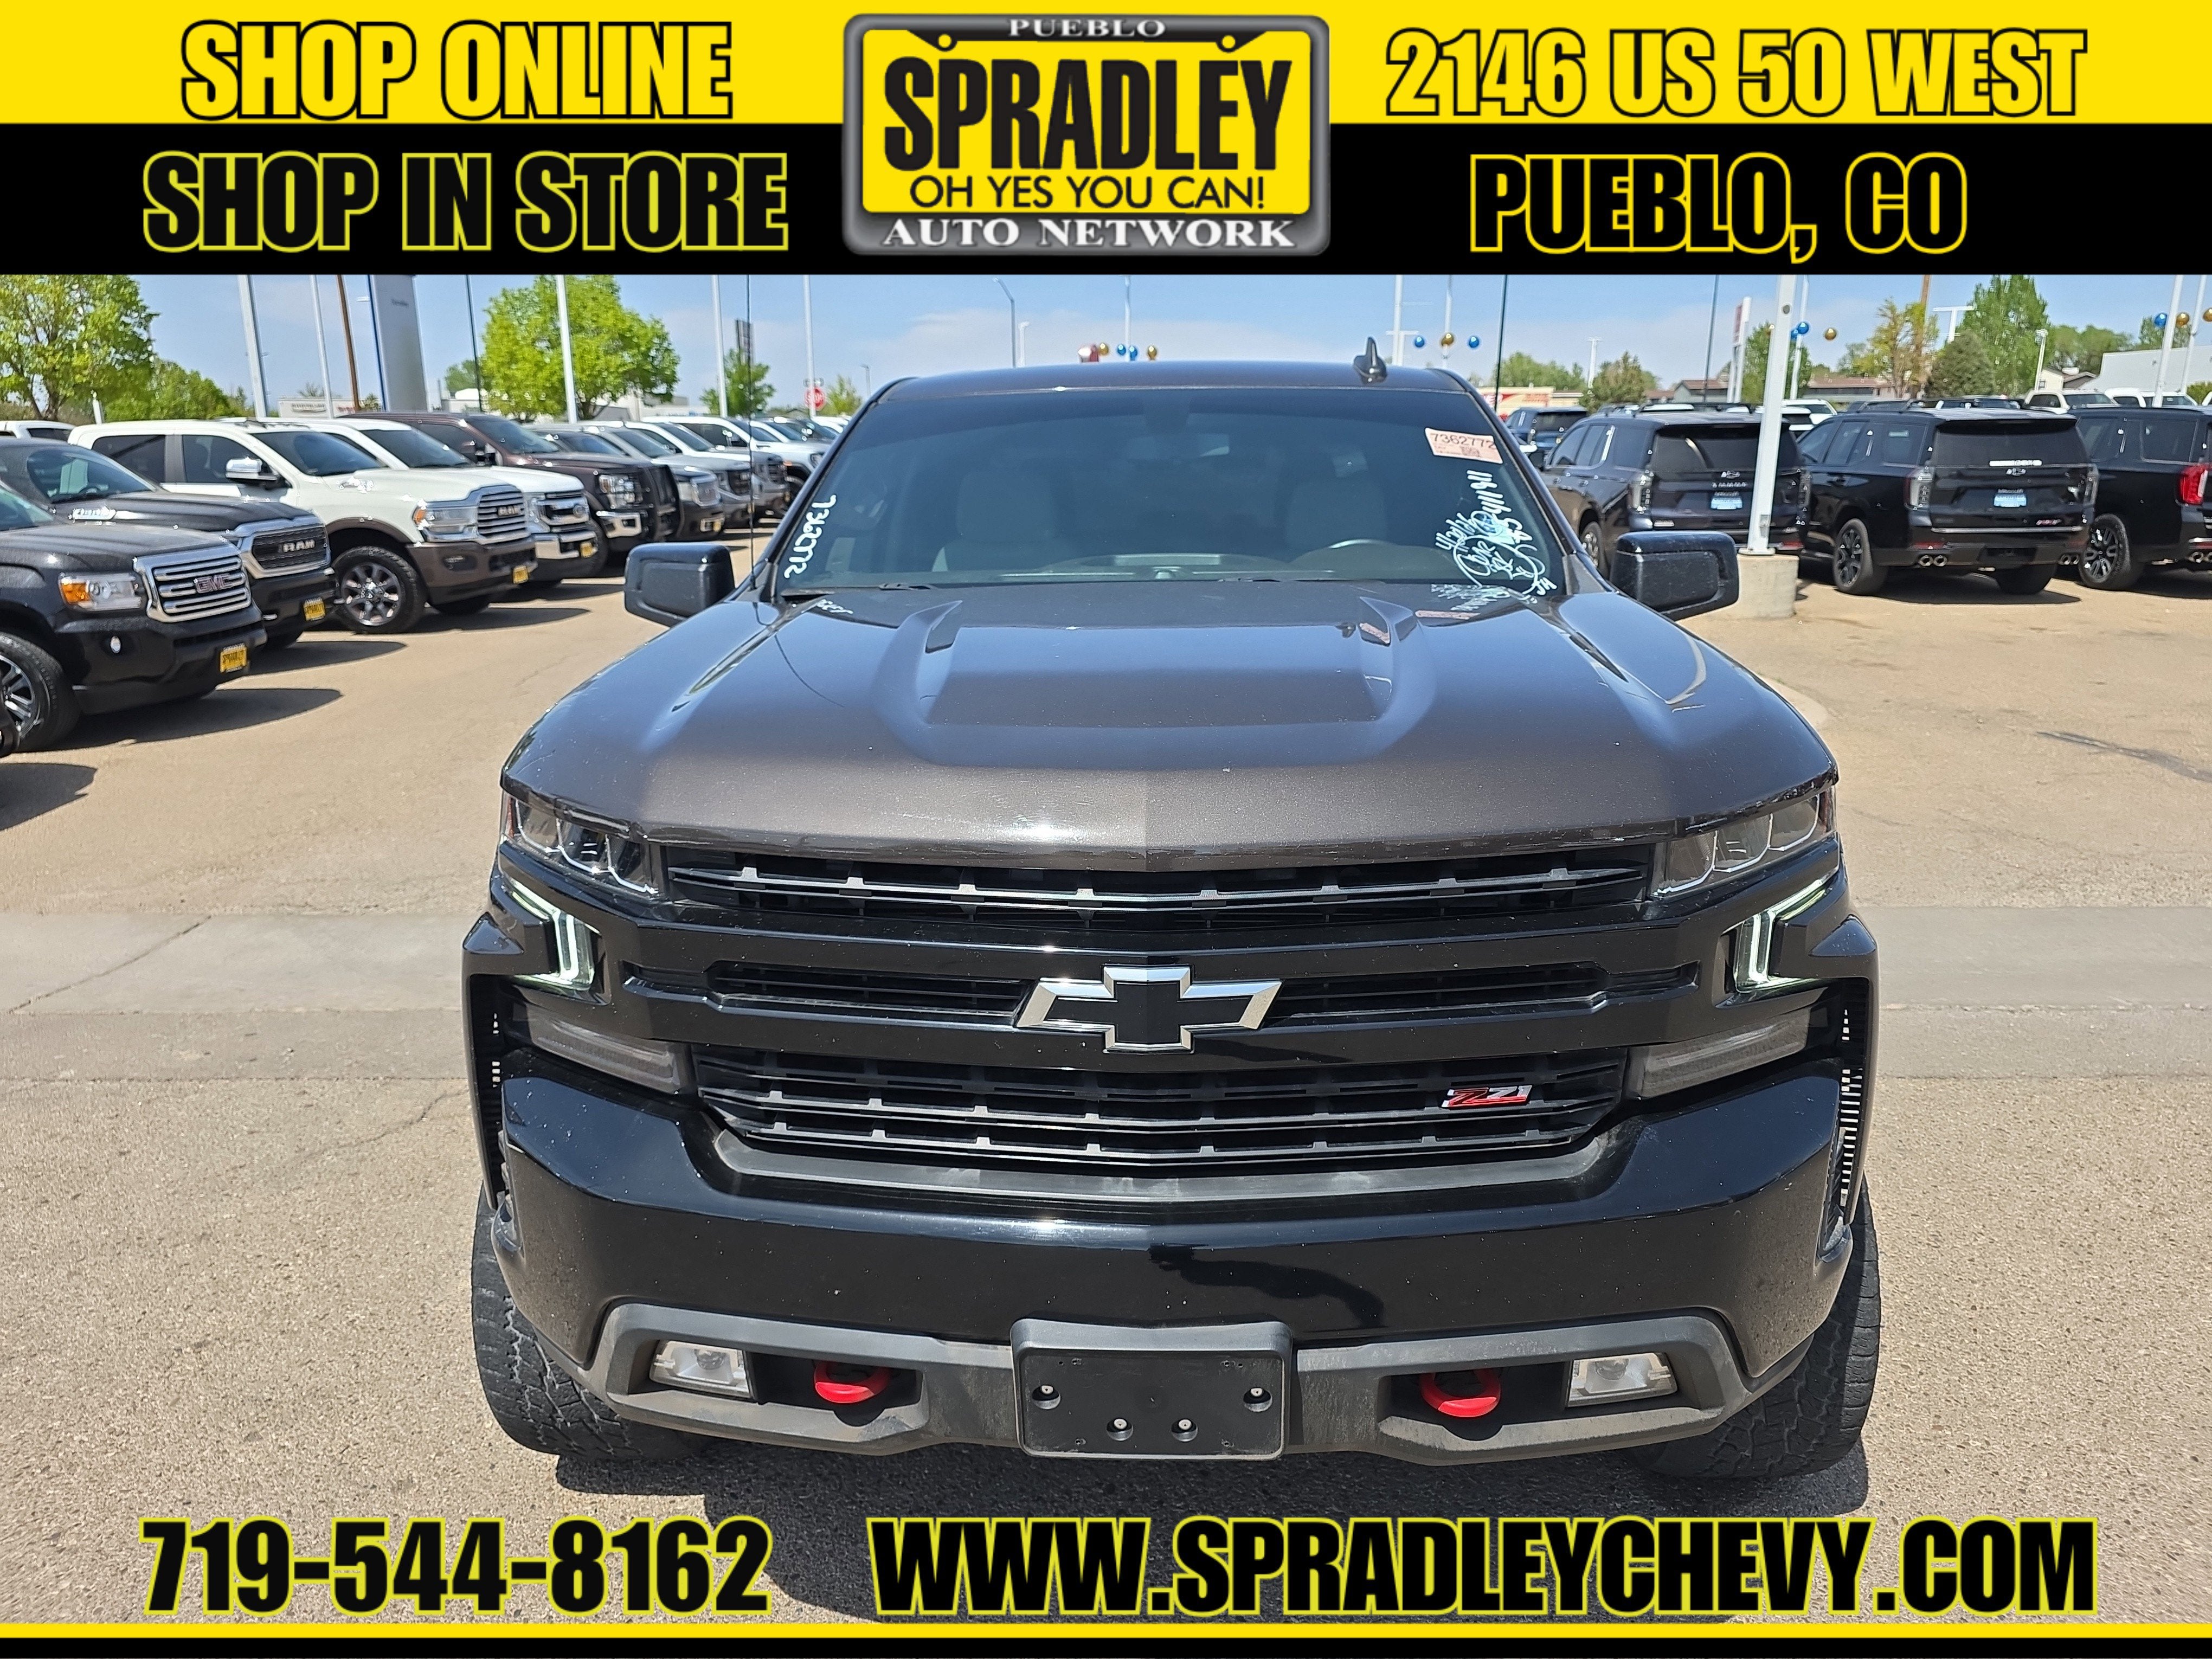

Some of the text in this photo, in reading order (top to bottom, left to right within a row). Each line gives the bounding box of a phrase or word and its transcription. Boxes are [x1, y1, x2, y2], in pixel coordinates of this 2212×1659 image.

[1430, 433, 1496, 449] 7362772
[283, 539, 315, 552] RAM
[196, 573, 230, 593] GMC
[1441, 1085, 1533, 1108] Z71
